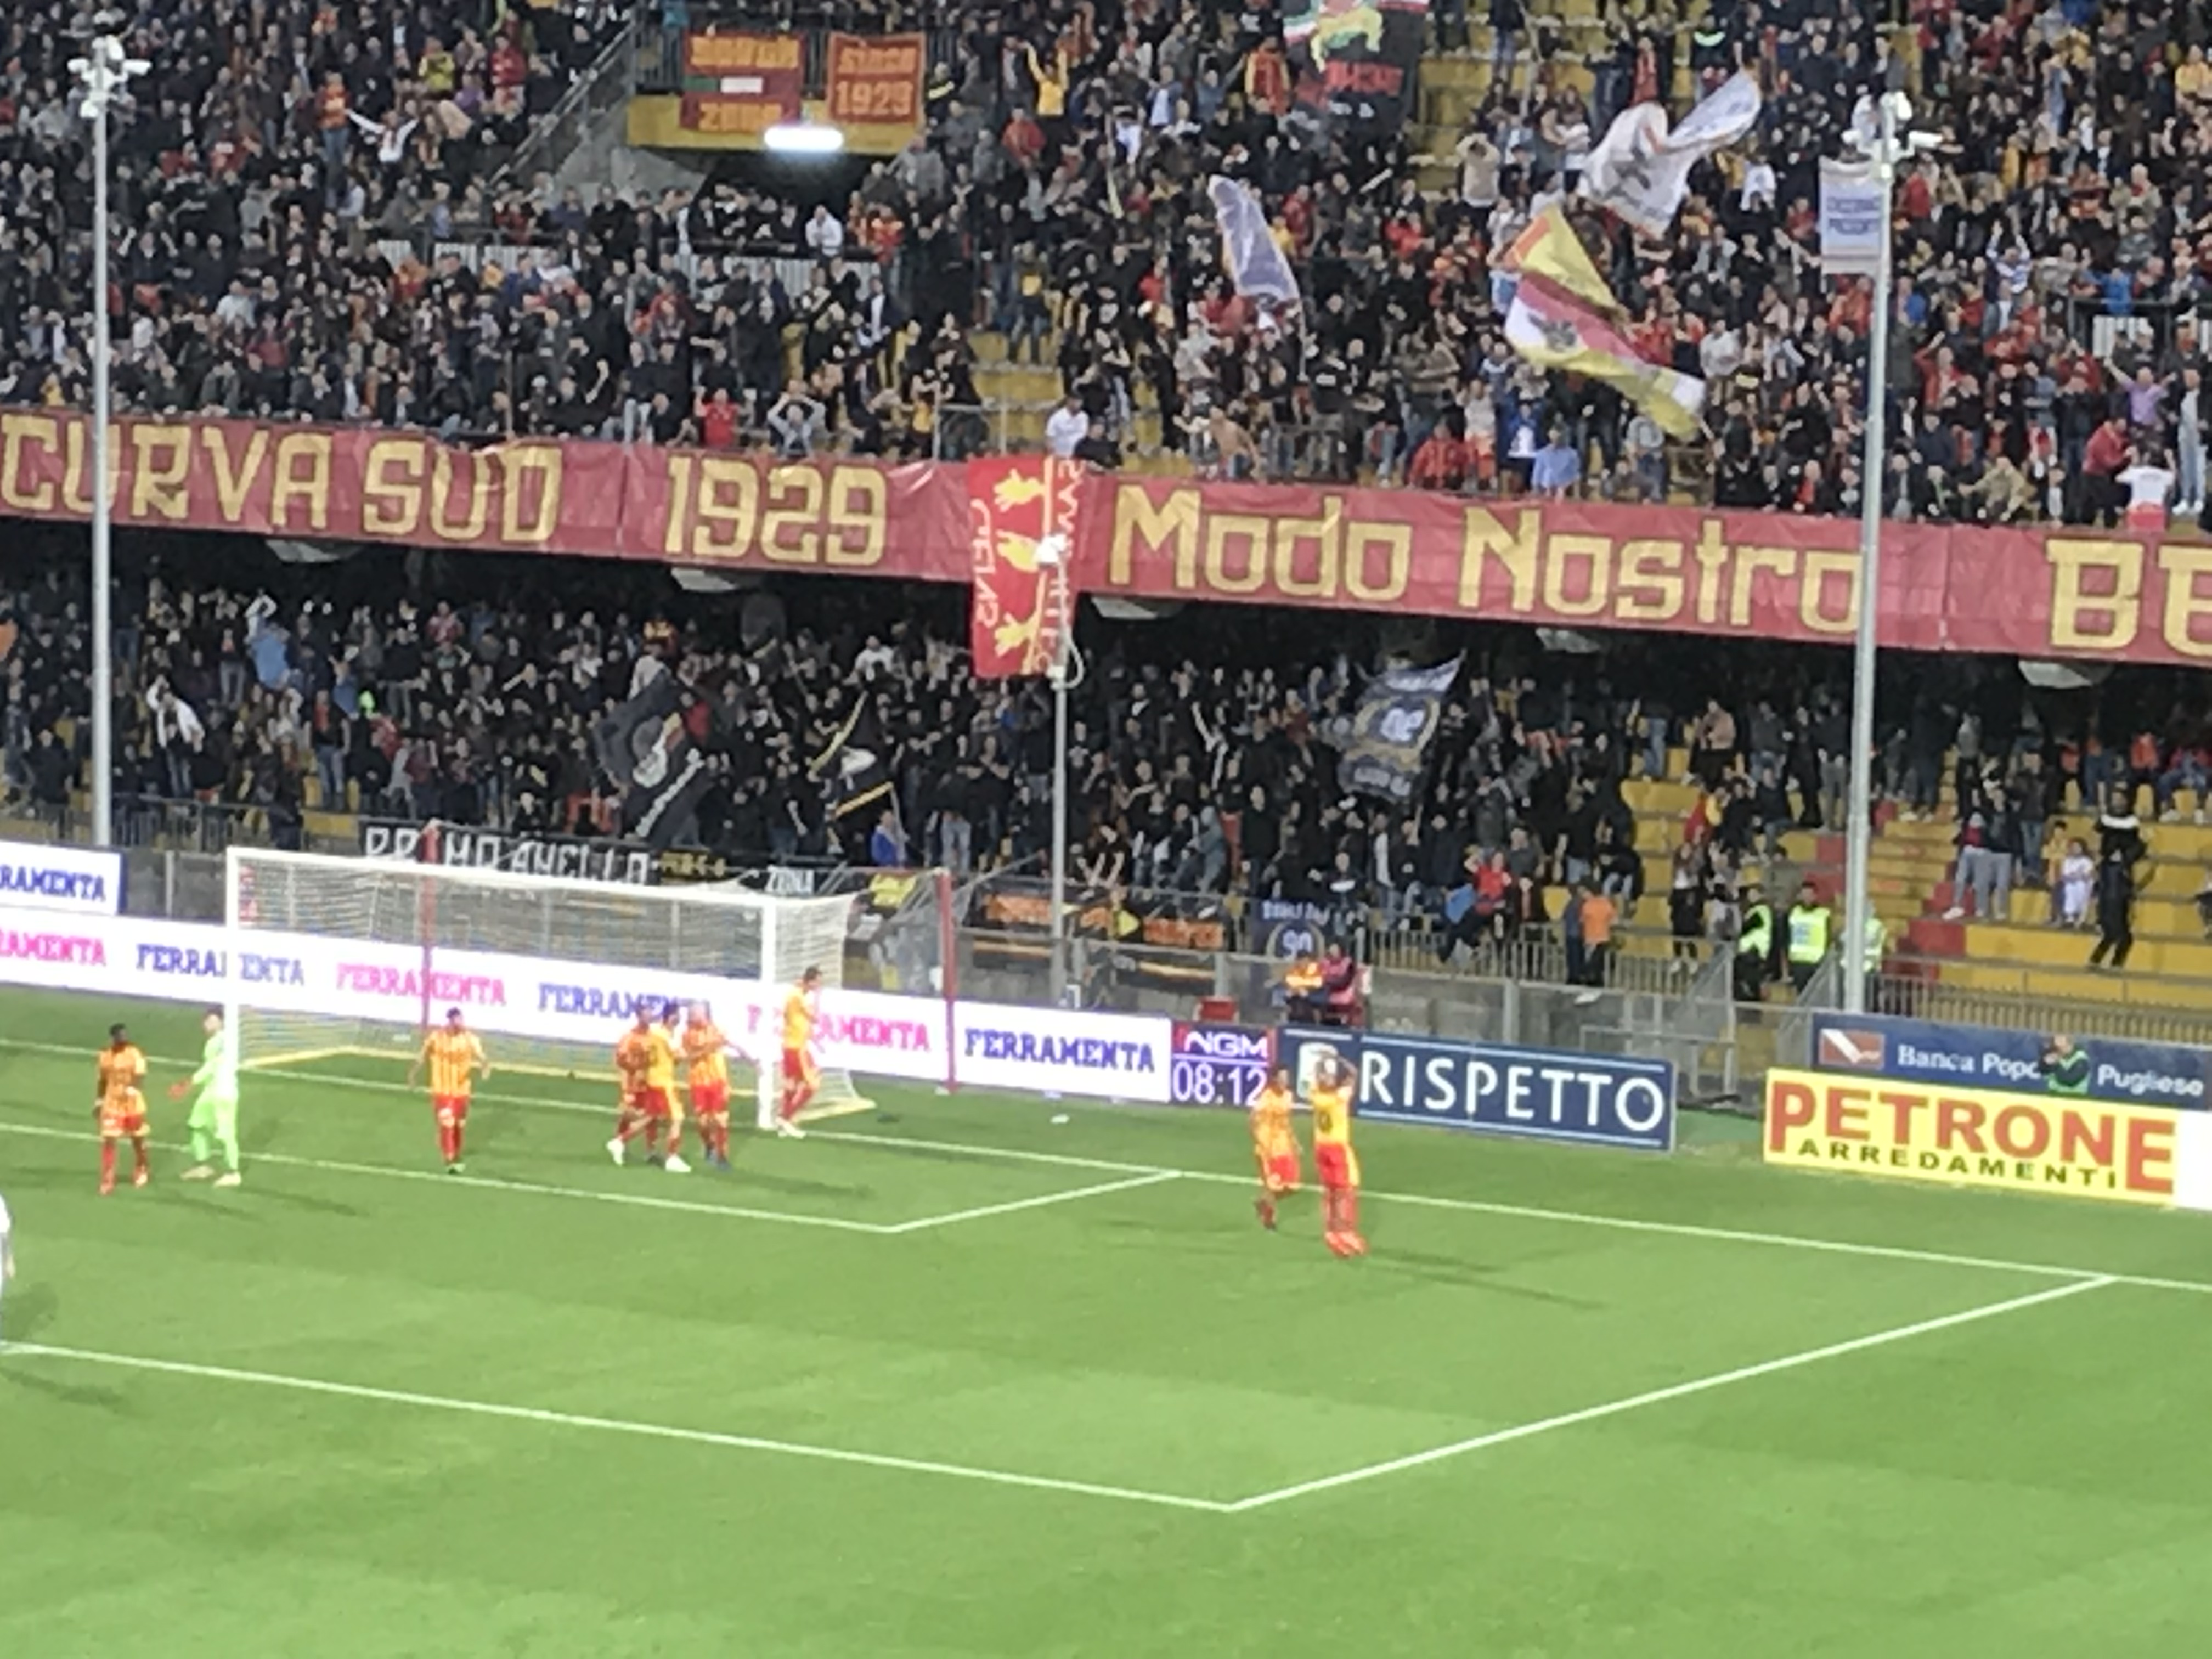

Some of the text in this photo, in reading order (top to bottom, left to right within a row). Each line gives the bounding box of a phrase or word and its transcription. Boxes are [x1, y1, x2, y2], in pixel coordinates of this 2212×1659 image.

[1, 414, 887, 566] CURVA SUD 1929
[1109, 484, 1413, 601] Modo
[1458, 506, 1864, 634] Nostro
[366, 827, 501, 867] PRMO
[136, 943, 304, 986] FERRAENTA
[964, 1028, 1155, 1073] FERRAMENTA
[1183, 1030, 1268, 1058] NGM
[1897, 1043, 1975, 1074] Banca
[2097, 1063, 2204, 1096] Pugliese
[1173, 1061, 1267, 1107] 08:12
[1359, 1050, 1664, 1132] RISPETTO
[1769, 1080, 2176, 1195] PETRONE
[1798, 1138, 2117, 1190] ARREDAMENTI
